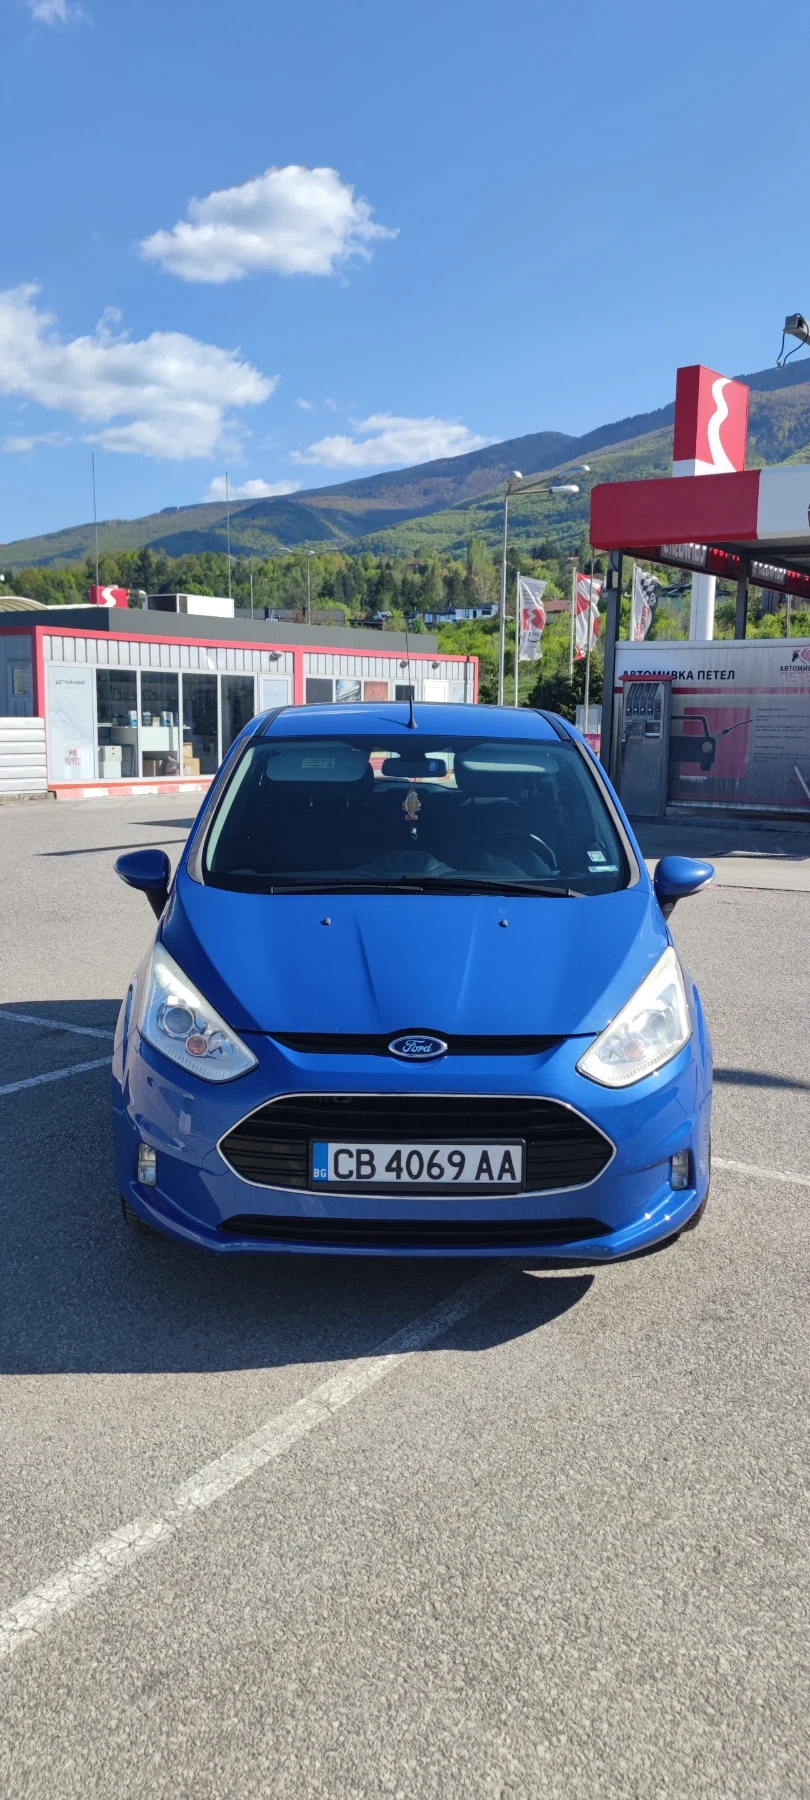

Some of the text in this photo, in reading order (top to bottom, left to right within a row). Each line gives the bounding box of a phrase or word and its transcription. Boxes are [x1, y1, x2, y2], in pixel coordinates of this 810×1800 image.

[697, 670, 735, 680] ПЕТЕЛ
[402, 1040, 433, 1053] Ford
[313, 1168, 327, 1178] BG
[385, 1149, 466, 1181] 4069
[474, 1150, 517, 1181] AA
